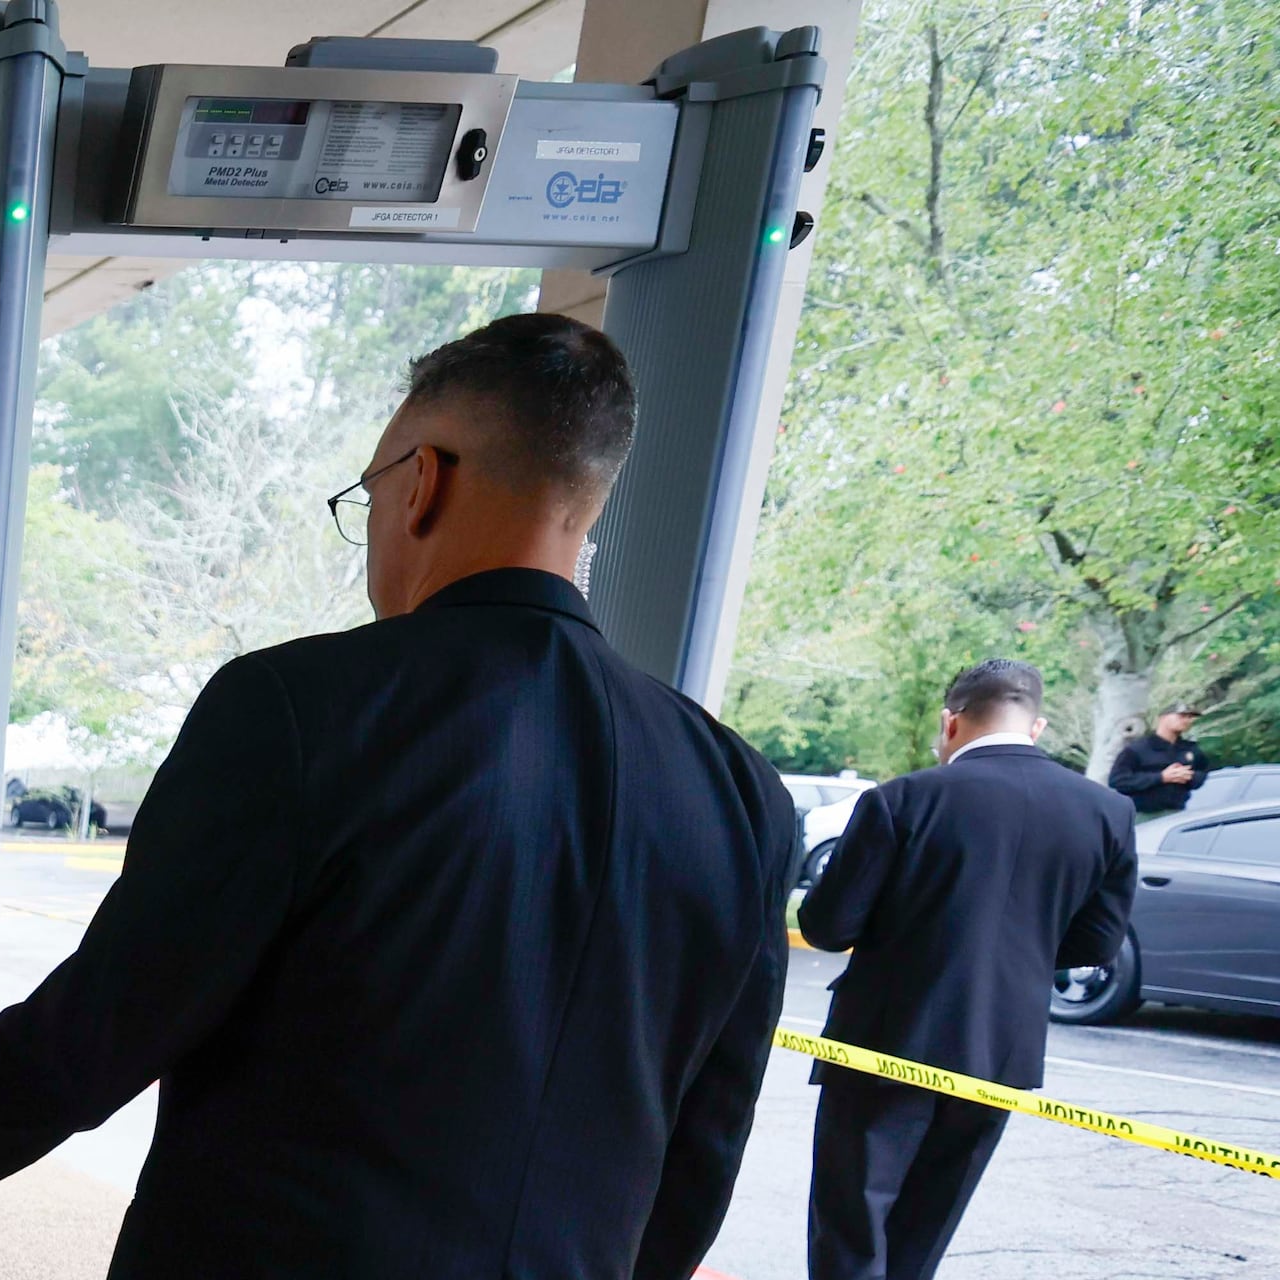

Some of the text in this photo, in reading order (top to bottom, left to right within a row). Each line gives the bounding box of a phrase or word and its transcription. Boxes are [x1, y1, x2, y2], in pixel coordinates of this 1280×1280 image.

[576, 147, 614, 156] DETECTOR
[208, 166, 269, 178] PMD2 Plus
[204, 177, 269, 187] Metal Detector
[371, 212, 391, 221] JFGA
[392, 212, 433, 222] DETECTOR
